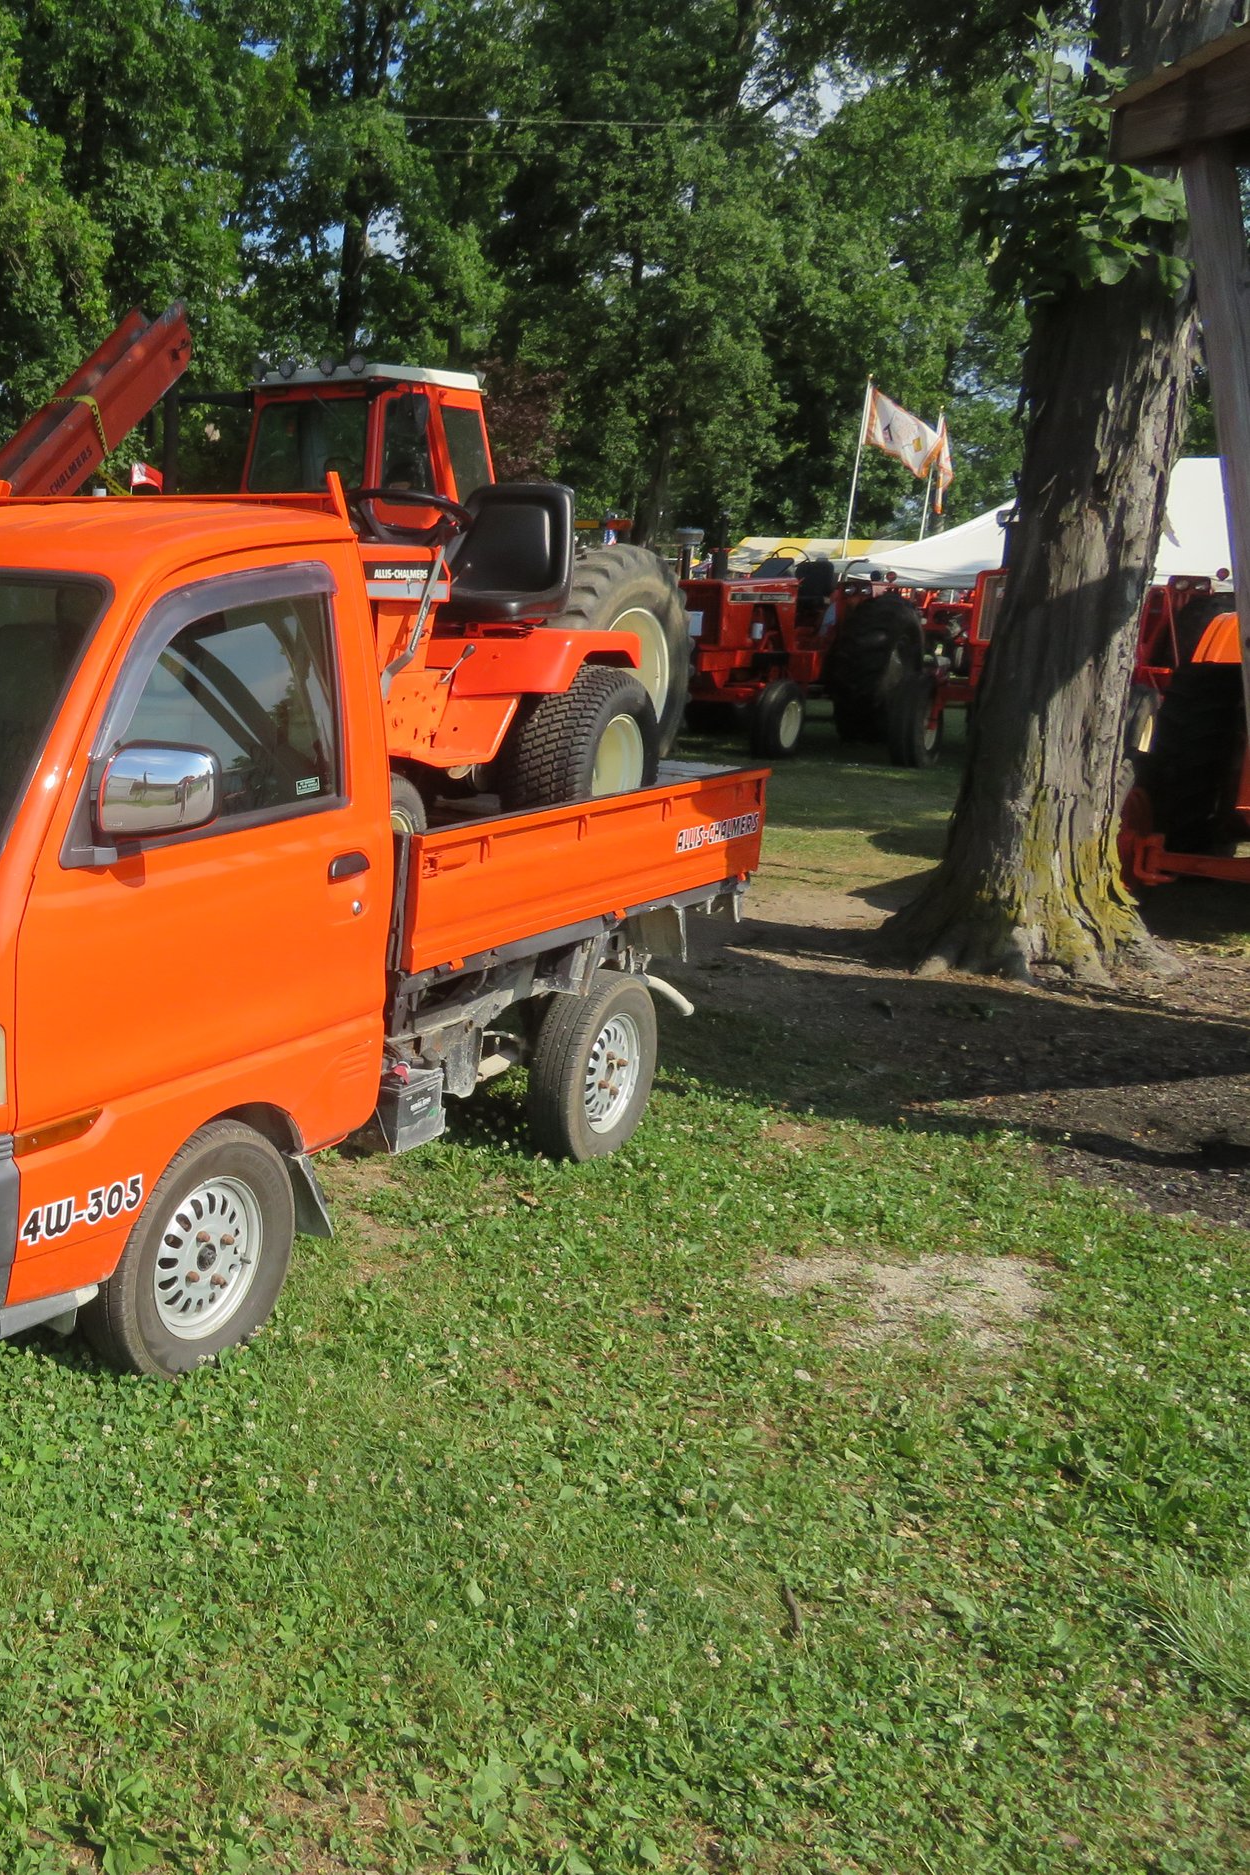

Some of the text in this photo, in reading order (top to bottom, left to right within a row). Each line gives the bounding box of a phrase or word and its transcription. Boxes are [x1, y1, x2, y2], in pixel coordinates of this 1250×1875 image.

[43, 446, 92, 496] -CHALMERS
[374, 569, 428, 578] ALLIS-CHALMERS
[676, 812, 759, 853] ALLIS-CHALMERS
[20, 1174, 143, 1246] 4W-305
